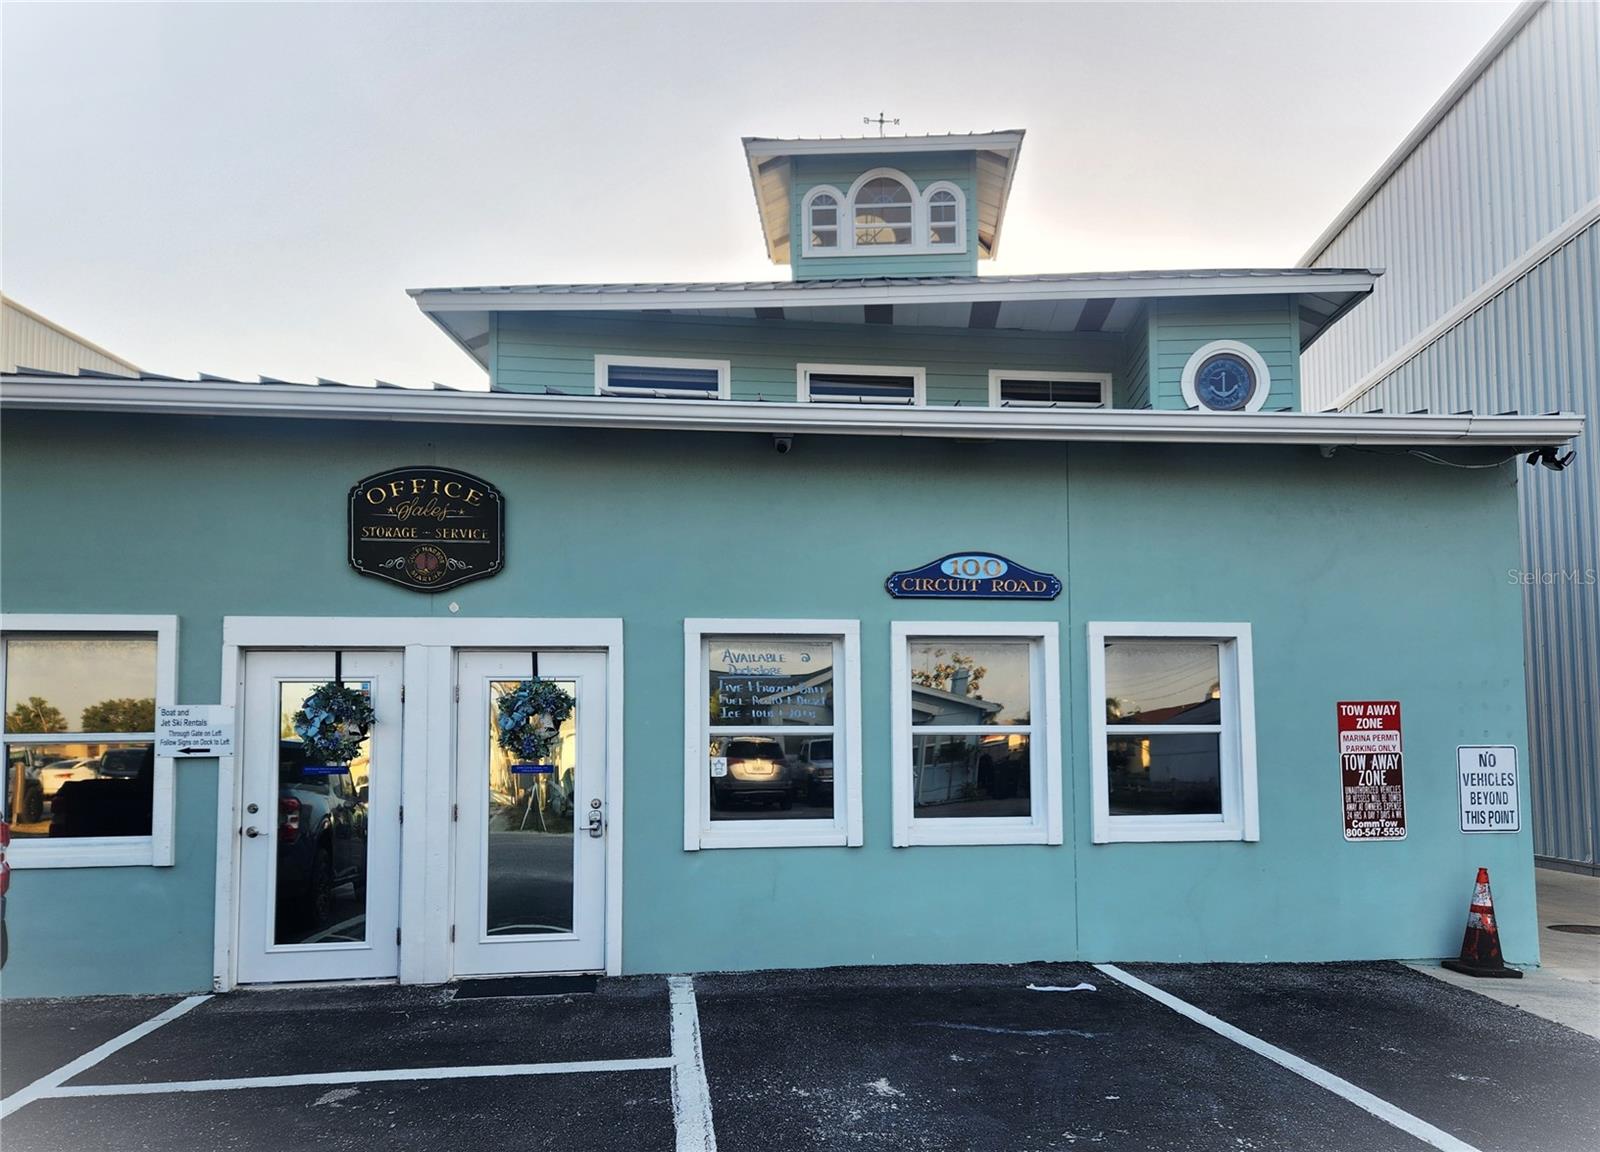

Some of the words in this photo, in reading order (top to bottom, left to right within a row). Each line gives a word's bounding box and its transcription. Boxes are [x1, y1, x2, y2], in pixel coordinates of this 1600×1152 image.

[366, 479, 484, 507] OFFICE
[396, 497, 452, 521] Sales
[362, 526, 418, 538] STORAGE
[435, 528, 489, 540] SERVICE
[950, 558, 1002, 576] 100
[901, 578, 982, 592] CIRCUIT
[992, 579, 1047, 592] ROAD
[722, 649, 787, 663] AVAILABLE
[1340, 705, 1364, 716] TOW
[1366, 704, 1397, 716] AWAY
[161, 719, 170, 727] Jet
[1356, 718, 1383, 729] ZONE
[1343, 734, 1371, 742] MARINA
[1372, 734, 1398, 742] PERMIT
[1378, 744, 1397, 752] ONLY
[1343, 755, 1366, 770] TOW
[1371, 754, 1399, 770] AWAY
[1479, 753, 1496, 767] NO
[1359, 770, 1387, 786] ZONE
[1462, 772, 1514, 786] VEHICLES
[1470, 791, 1508, 805] BEYOND
[1352, 819, 1398, 828] CommTow
[1465, 810, 1486, 824] THIS
[1488, 810, 1515, 824] POINT
[1346, 828, 1405, 837] 800-547-5550
